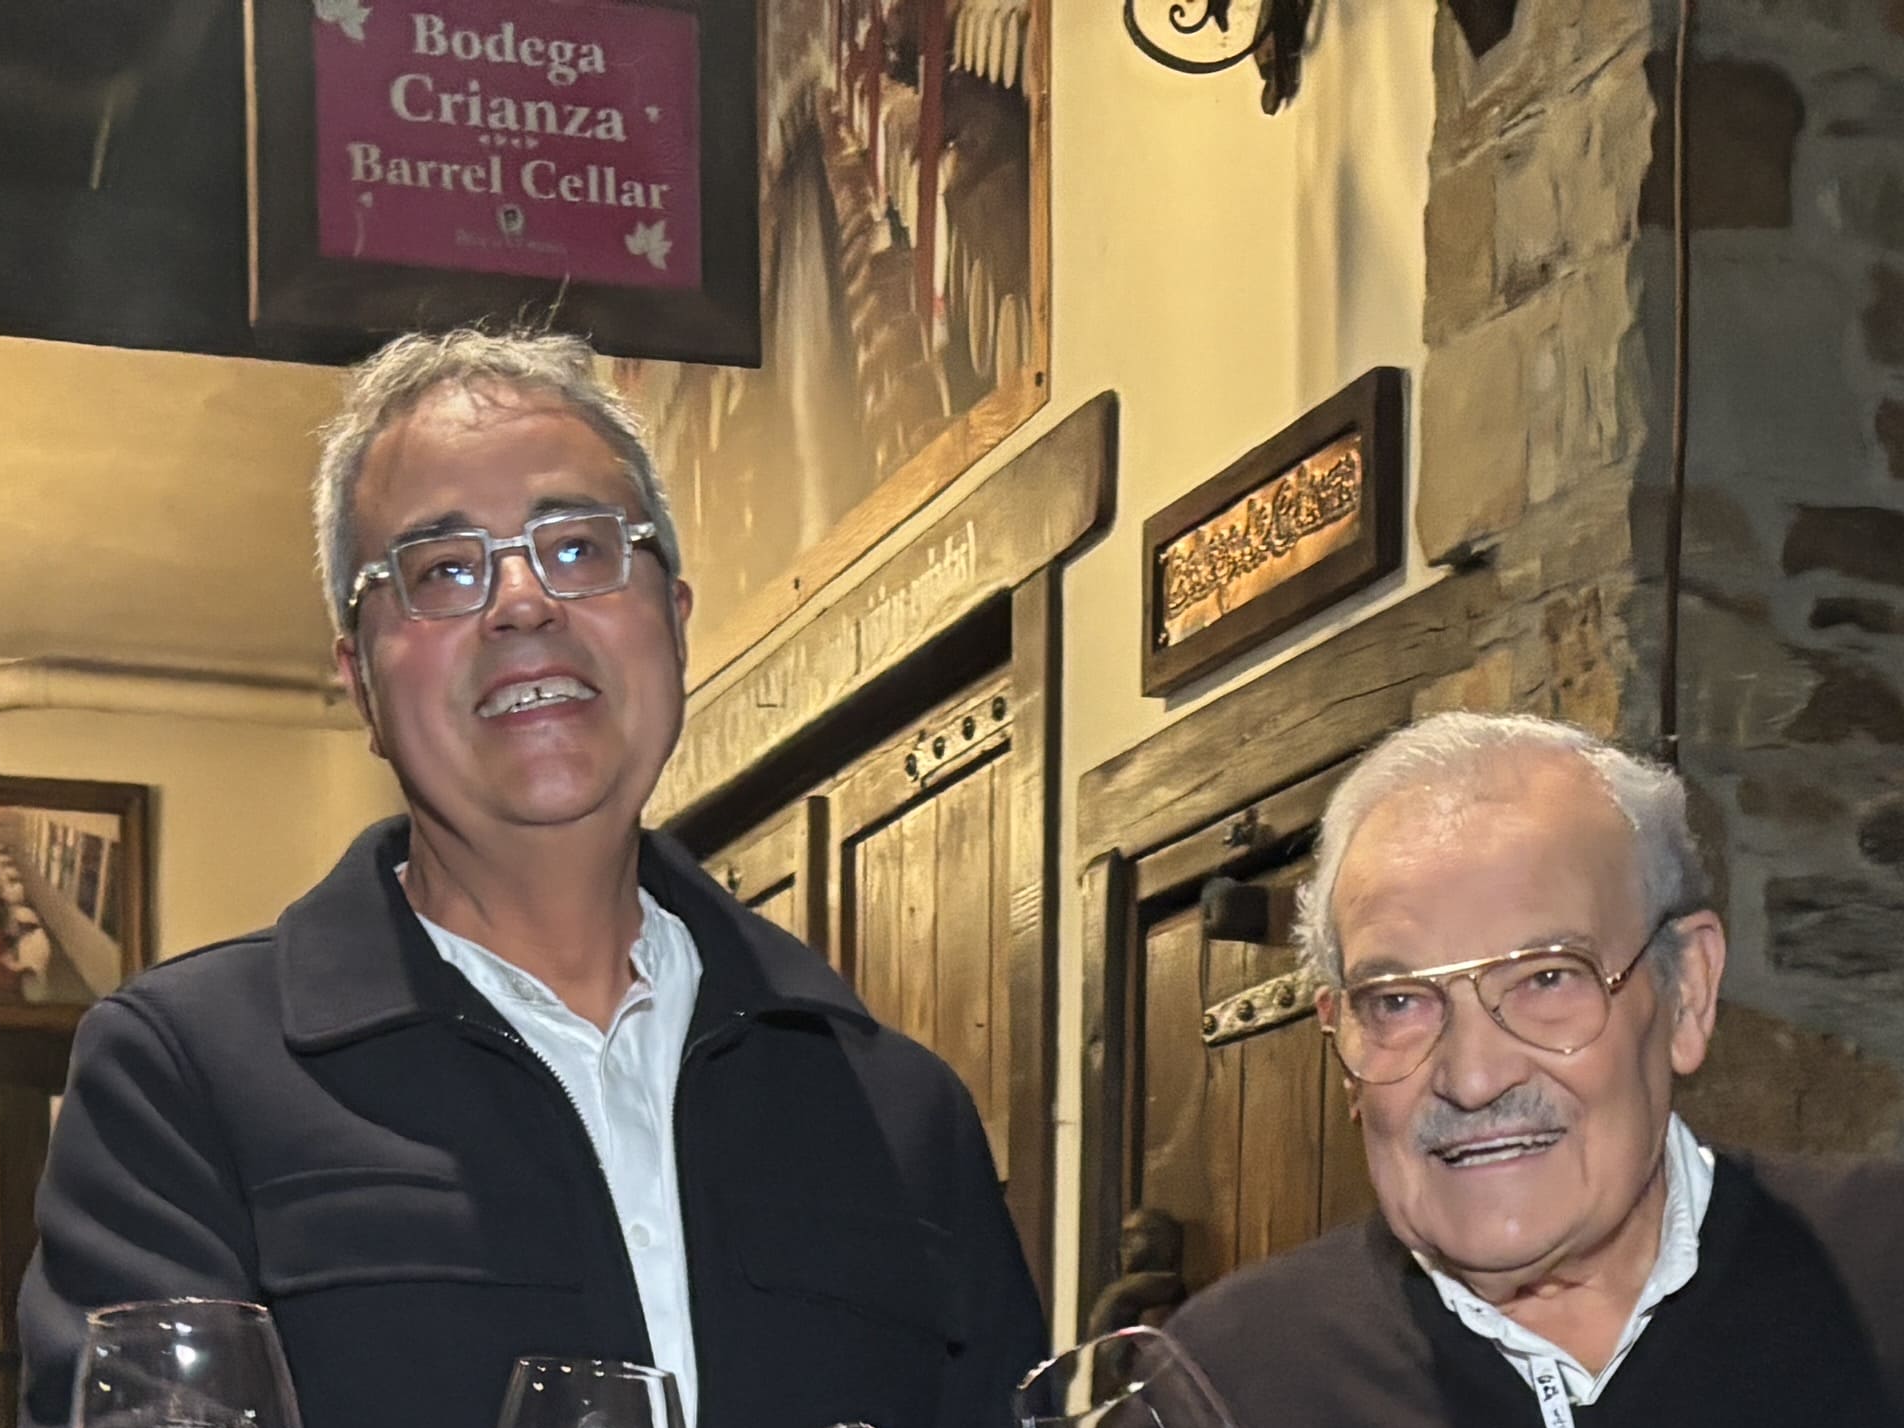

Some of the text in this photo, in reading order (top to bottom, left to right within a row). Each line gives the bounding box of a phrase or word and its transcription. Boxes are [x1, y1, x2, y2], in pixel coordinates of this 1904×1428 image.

[411, 13, 606, 86] Bodega
[389, 72, 628, 143] Crianza
[346, 142, 672, 211] Barrel Cellar
